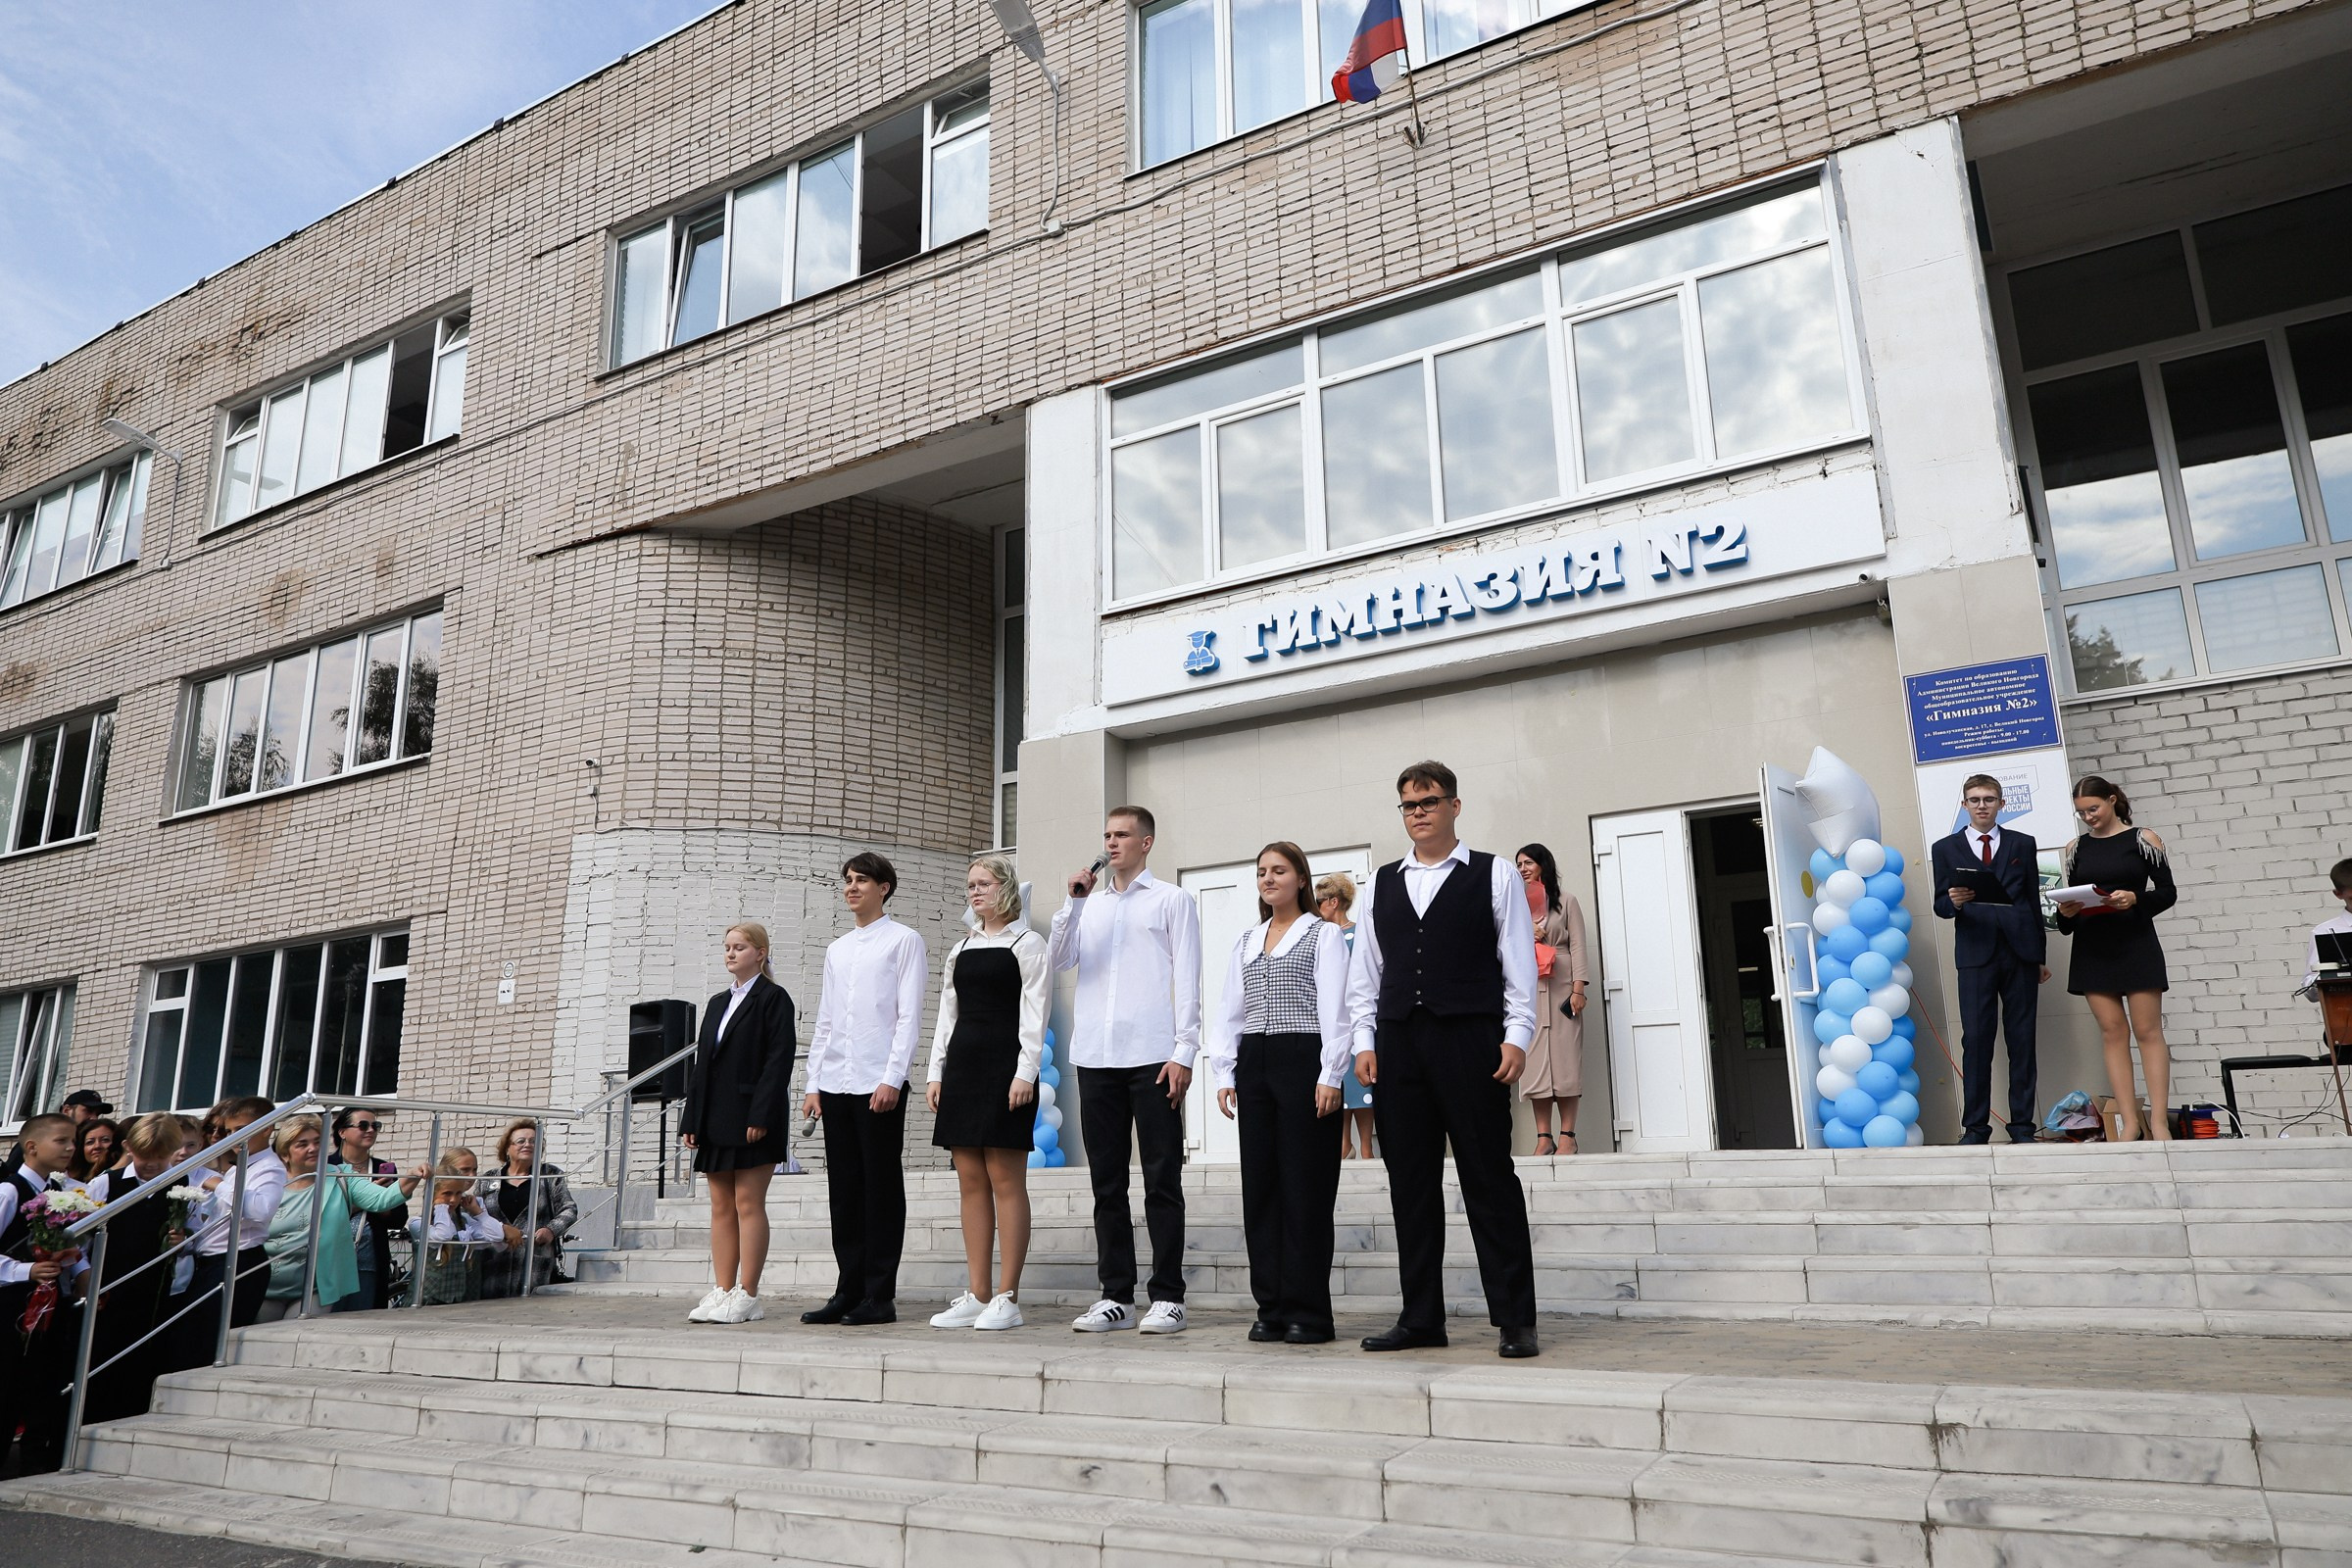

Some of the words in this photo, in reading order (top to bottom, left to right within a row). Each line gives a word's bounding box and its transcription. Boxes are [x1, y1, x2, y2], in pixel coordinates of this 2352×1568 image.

[1243, 539, 1625, 661] ГИМНАЗИЯ
[1917, 684, 1969, 697] Администрации
[2003, 673, 2039, 683] Новгорода
[1935, 678, 1962, 686] Комитет
[1974, 669, 2017, 680] образованию
[1924, 695, 1995, 709] общеобразовательное
[1995, 688, 2036, 699] учреждение
[1932, 688, 1985, 701] Муниципальное
[1986, 683, 2026, 693] автономное
[1926, 704, 2002, 722] «Гимназия
[2005, 697, 2037, 711] №2»
[1994, 773, 2029, 782] ОВАНИЕ
[2002, 794, 2030, 805] ОЕКТЫ
[2003, 785, 2029, 796] ЛЬНЫЕ
